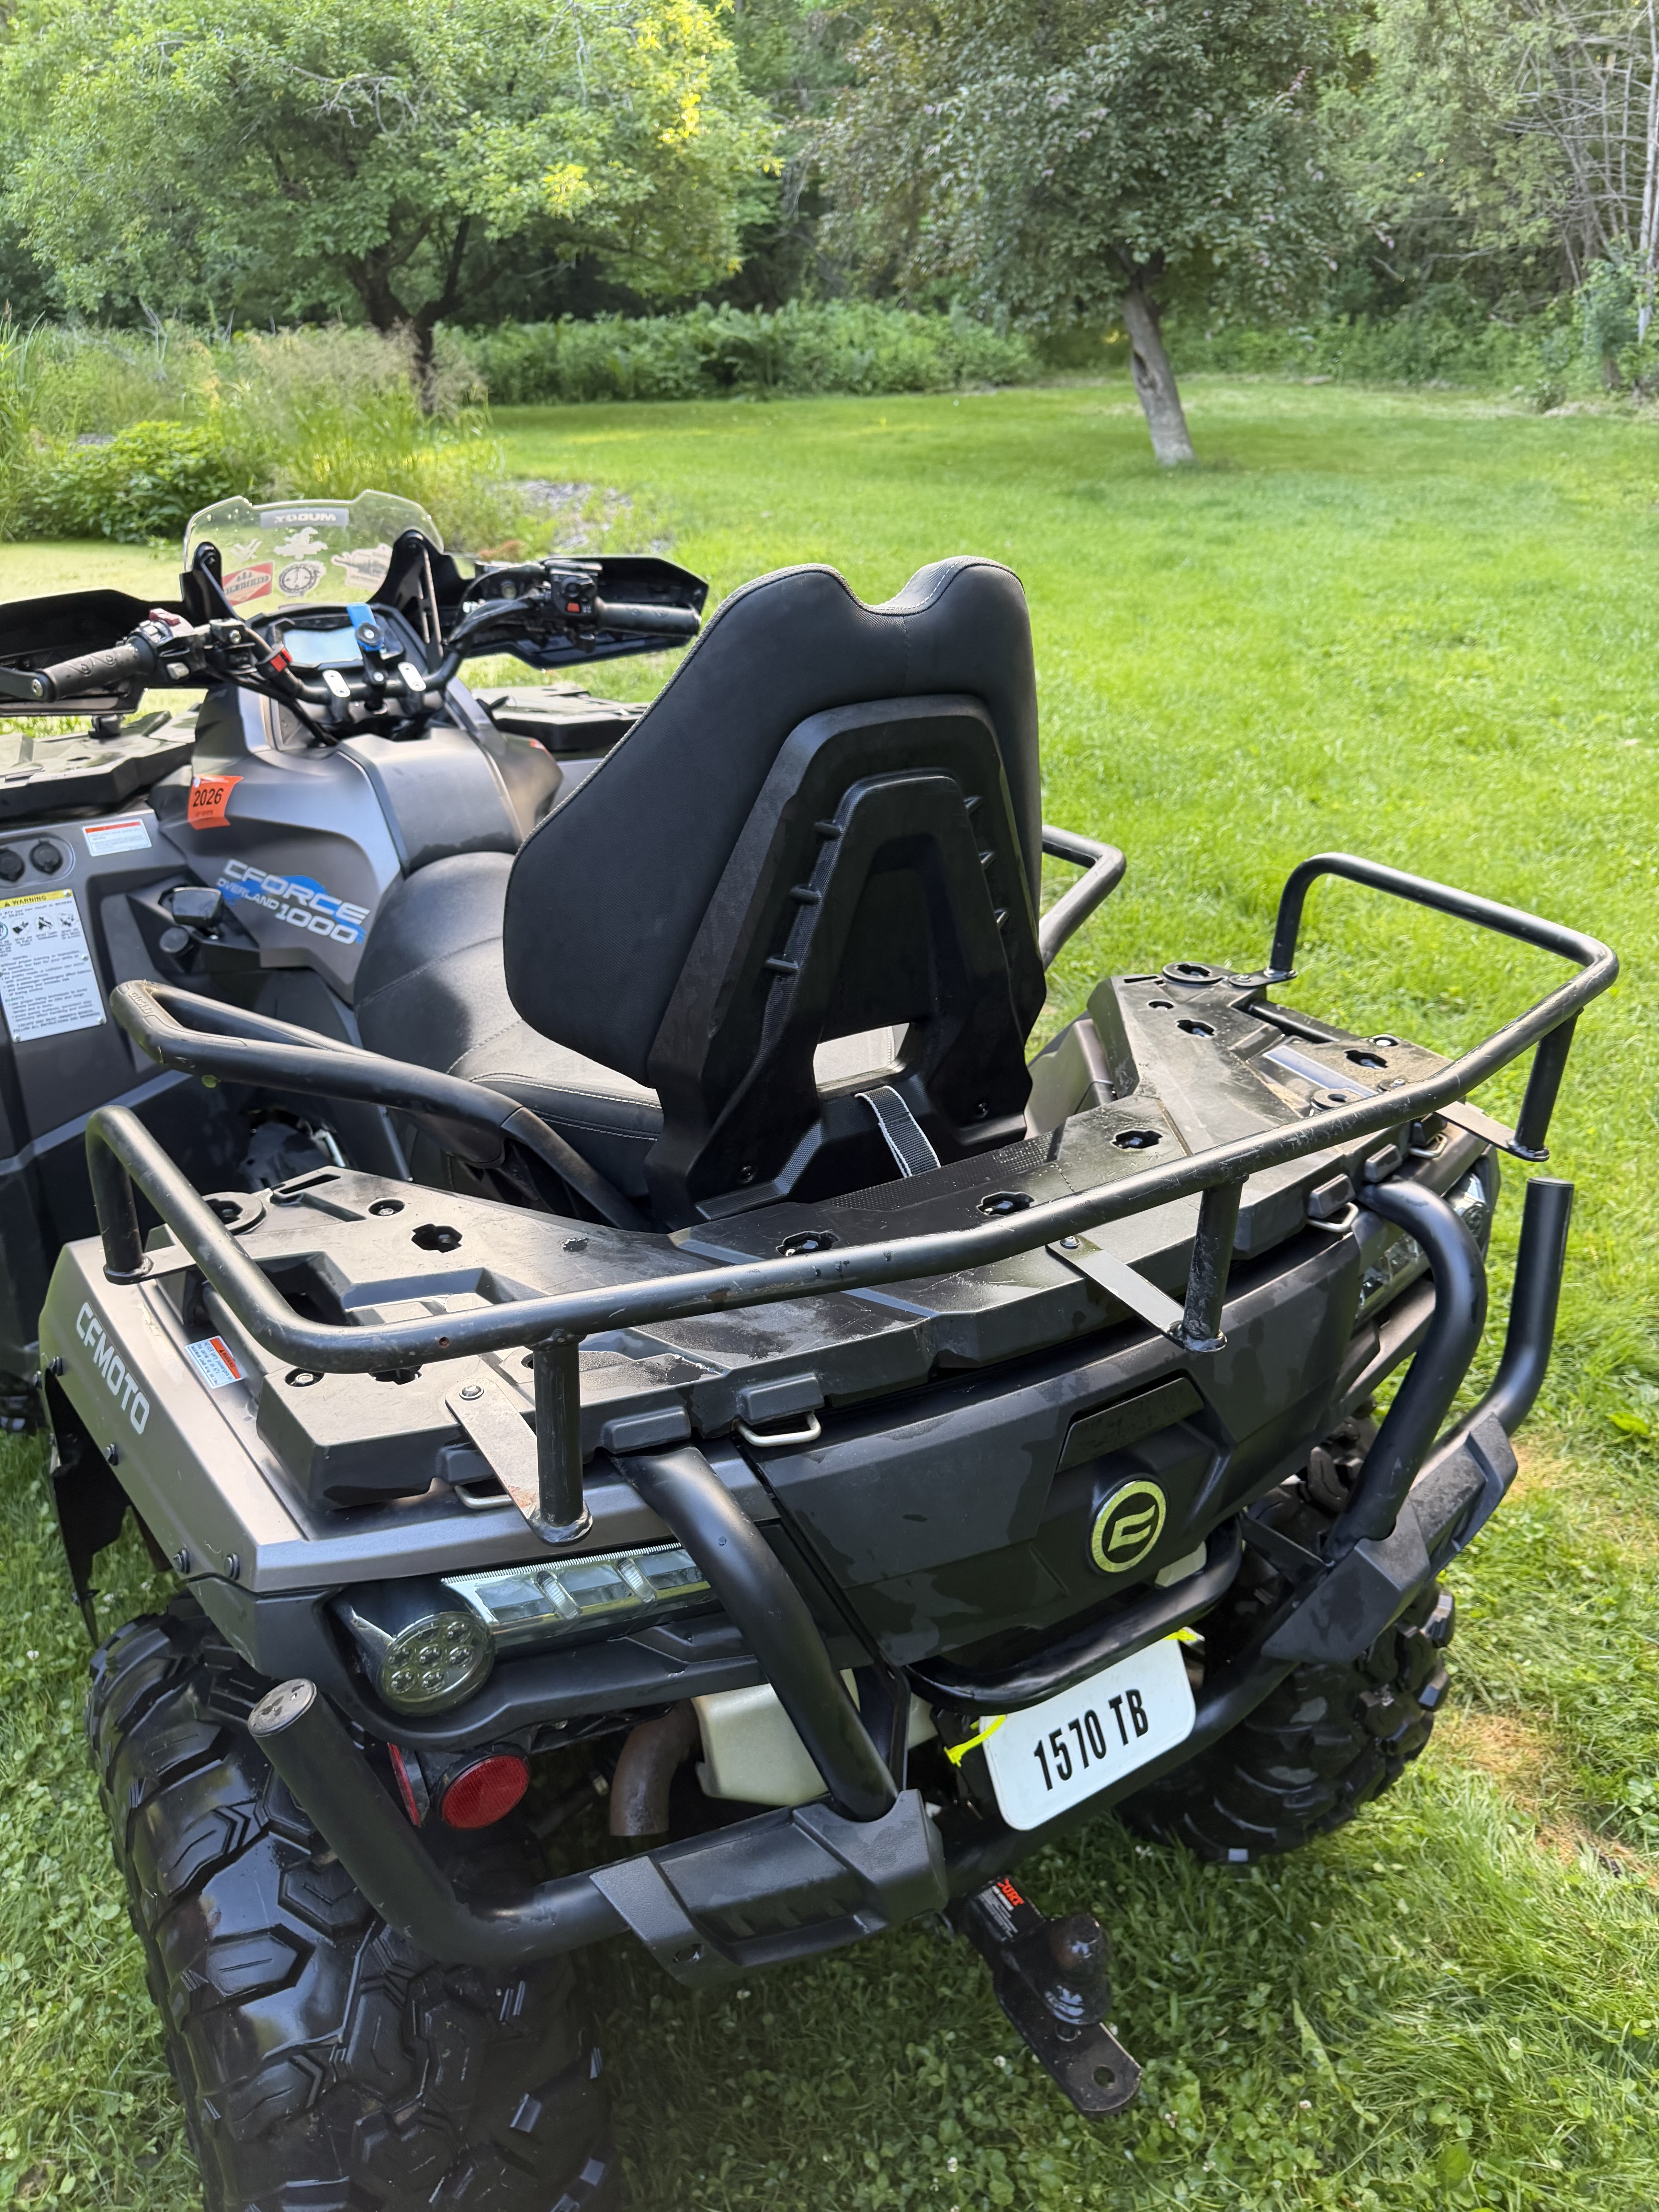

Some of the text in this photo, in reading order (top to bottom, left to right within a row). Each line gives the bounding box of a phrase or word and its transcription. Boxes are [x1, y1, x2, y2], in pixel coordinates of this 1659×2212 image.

[192, 788, 224, 807] 2026
[13, 895, 47, 906] WARNING
[216, 877, 358, 945] OVERLAND 1000
[223, 859, 370, 925] CFORCE
[76, 1302, 150, 1435] CFMOTO
[1033, 1688, 1149, 1792] 1570 TB
